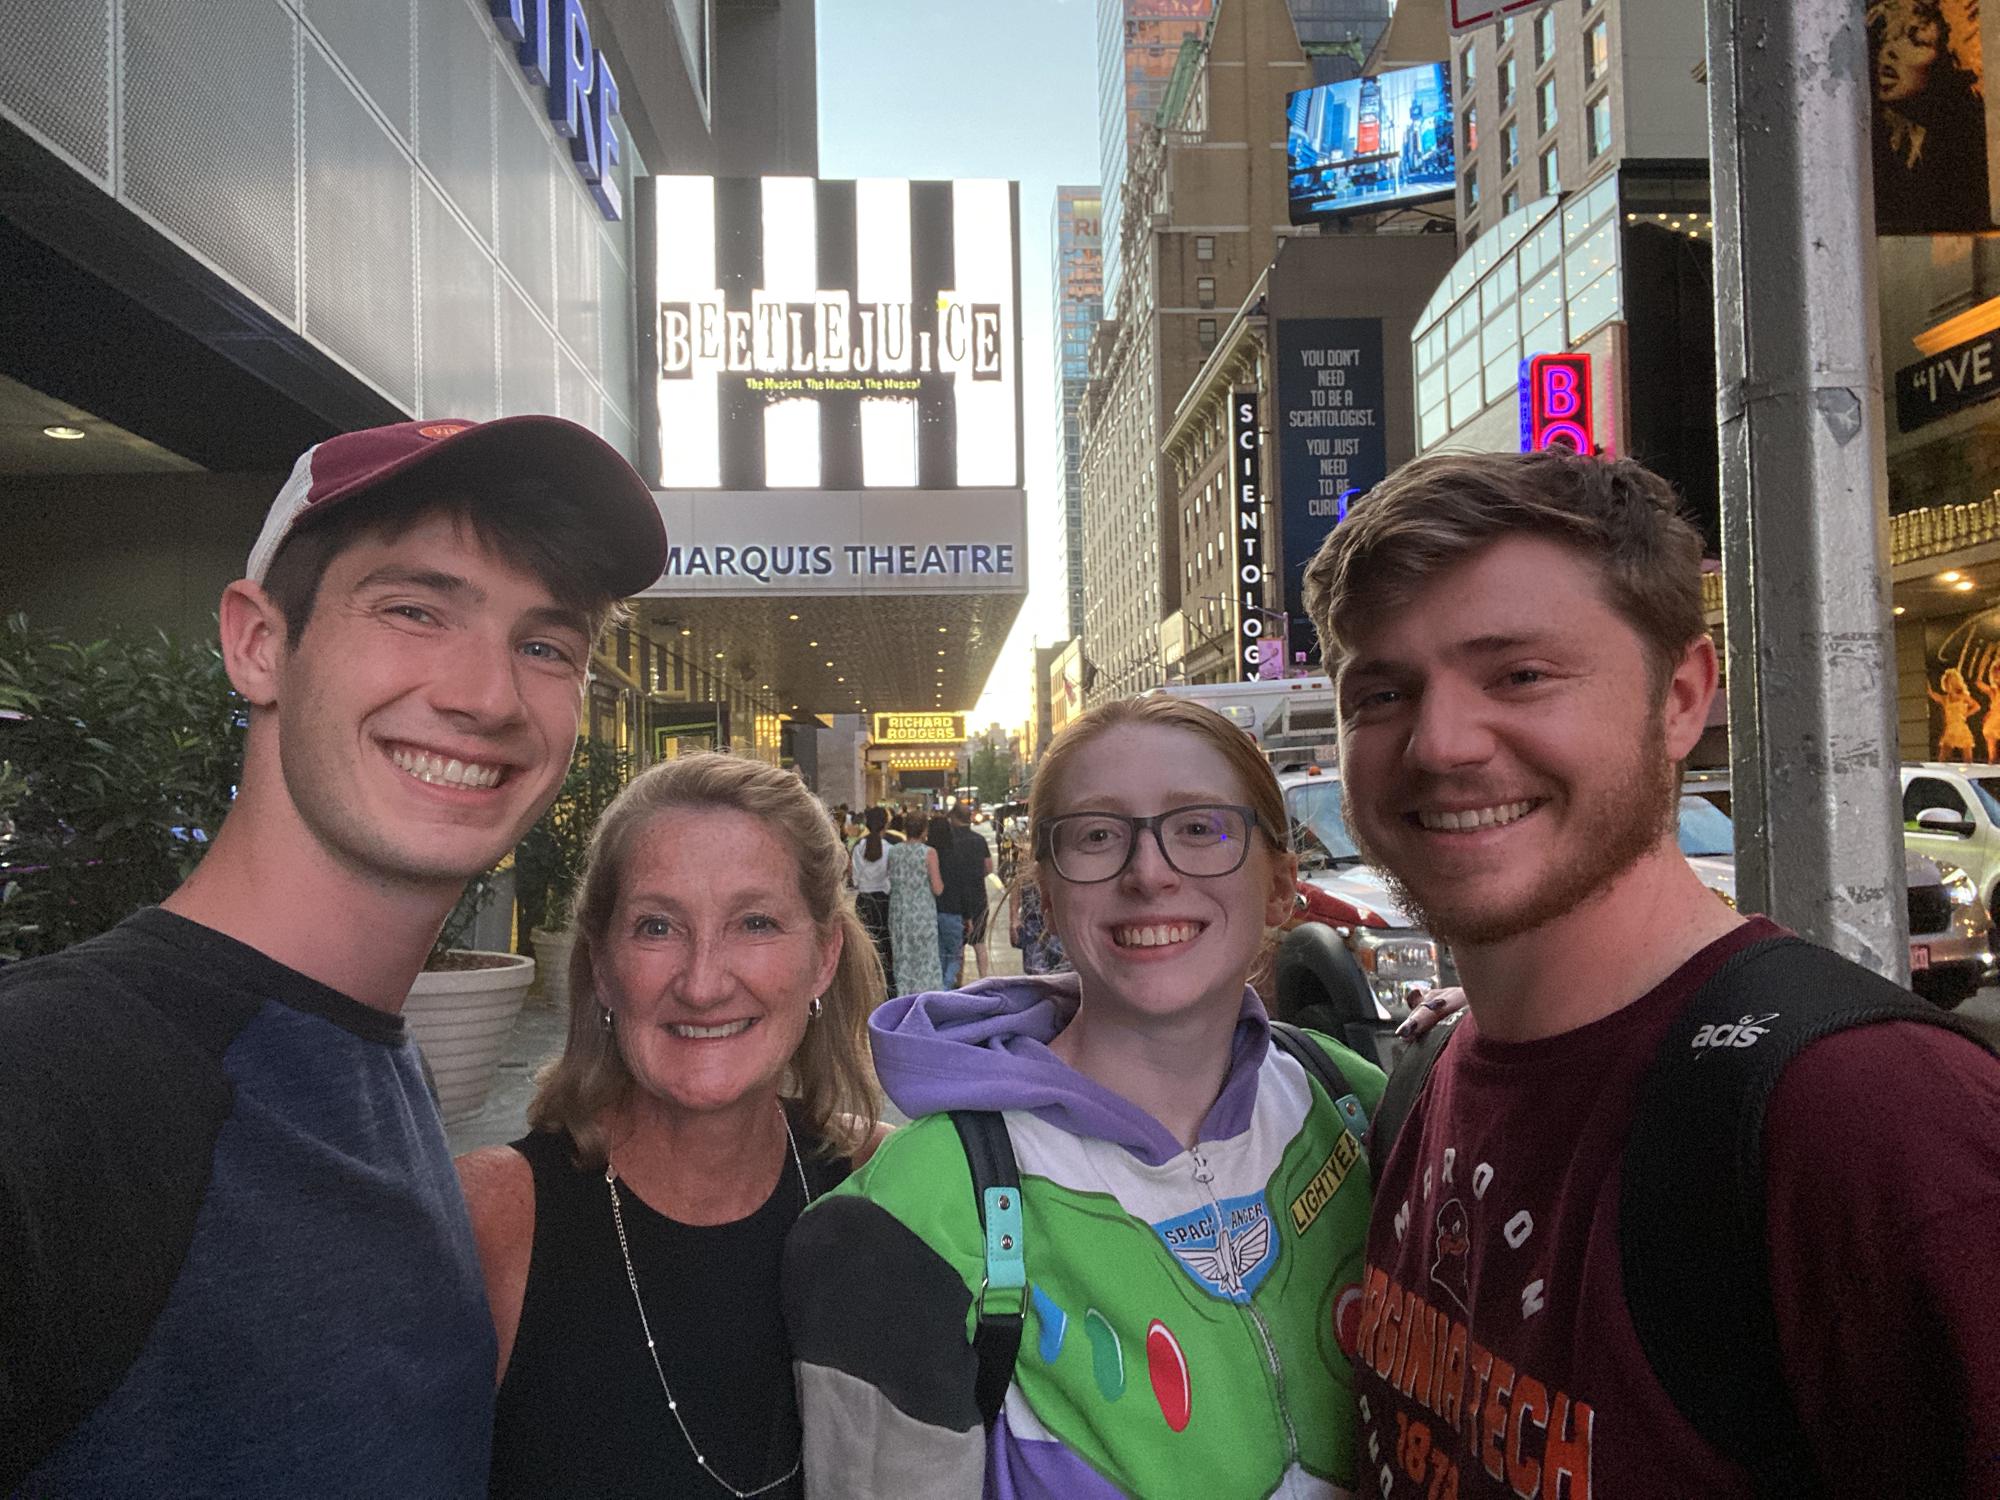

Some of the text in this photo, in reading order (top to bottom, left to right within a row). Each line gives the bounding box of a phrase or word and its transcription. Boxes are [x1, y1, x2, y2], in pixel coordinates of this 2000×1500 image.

[1075, 219, 1098, 236] RI
[663, 302, 1000, 372] BEETLEJUICE
[1300, 350, 1360, 367] YOU DON'T
[746, 378, 763, 390] The
[805, 378, 824, 390] The
[865, 378, 883, 390] The
[1317, 369, 1345, 387] NEED
[1310, 390, 1353, 407] TO BE A
[1289, 409, 1376, 427] SCIENTOLOGIST.
[1306, 438, 1360, 456] YOU JUST
[1320, 459, 1347, 476] NEED
[1318, 479, 1350, 496] TO BE
[844, 545, 1013, 575] THEATRE
[888, 717, 954, 728] RICHARD
[887, 727, 955, 739] RODGERS
[1292, 1131, 1361, 1229] LIGHTYEA
[1231, 1202, 1264, 1230] ANGER
